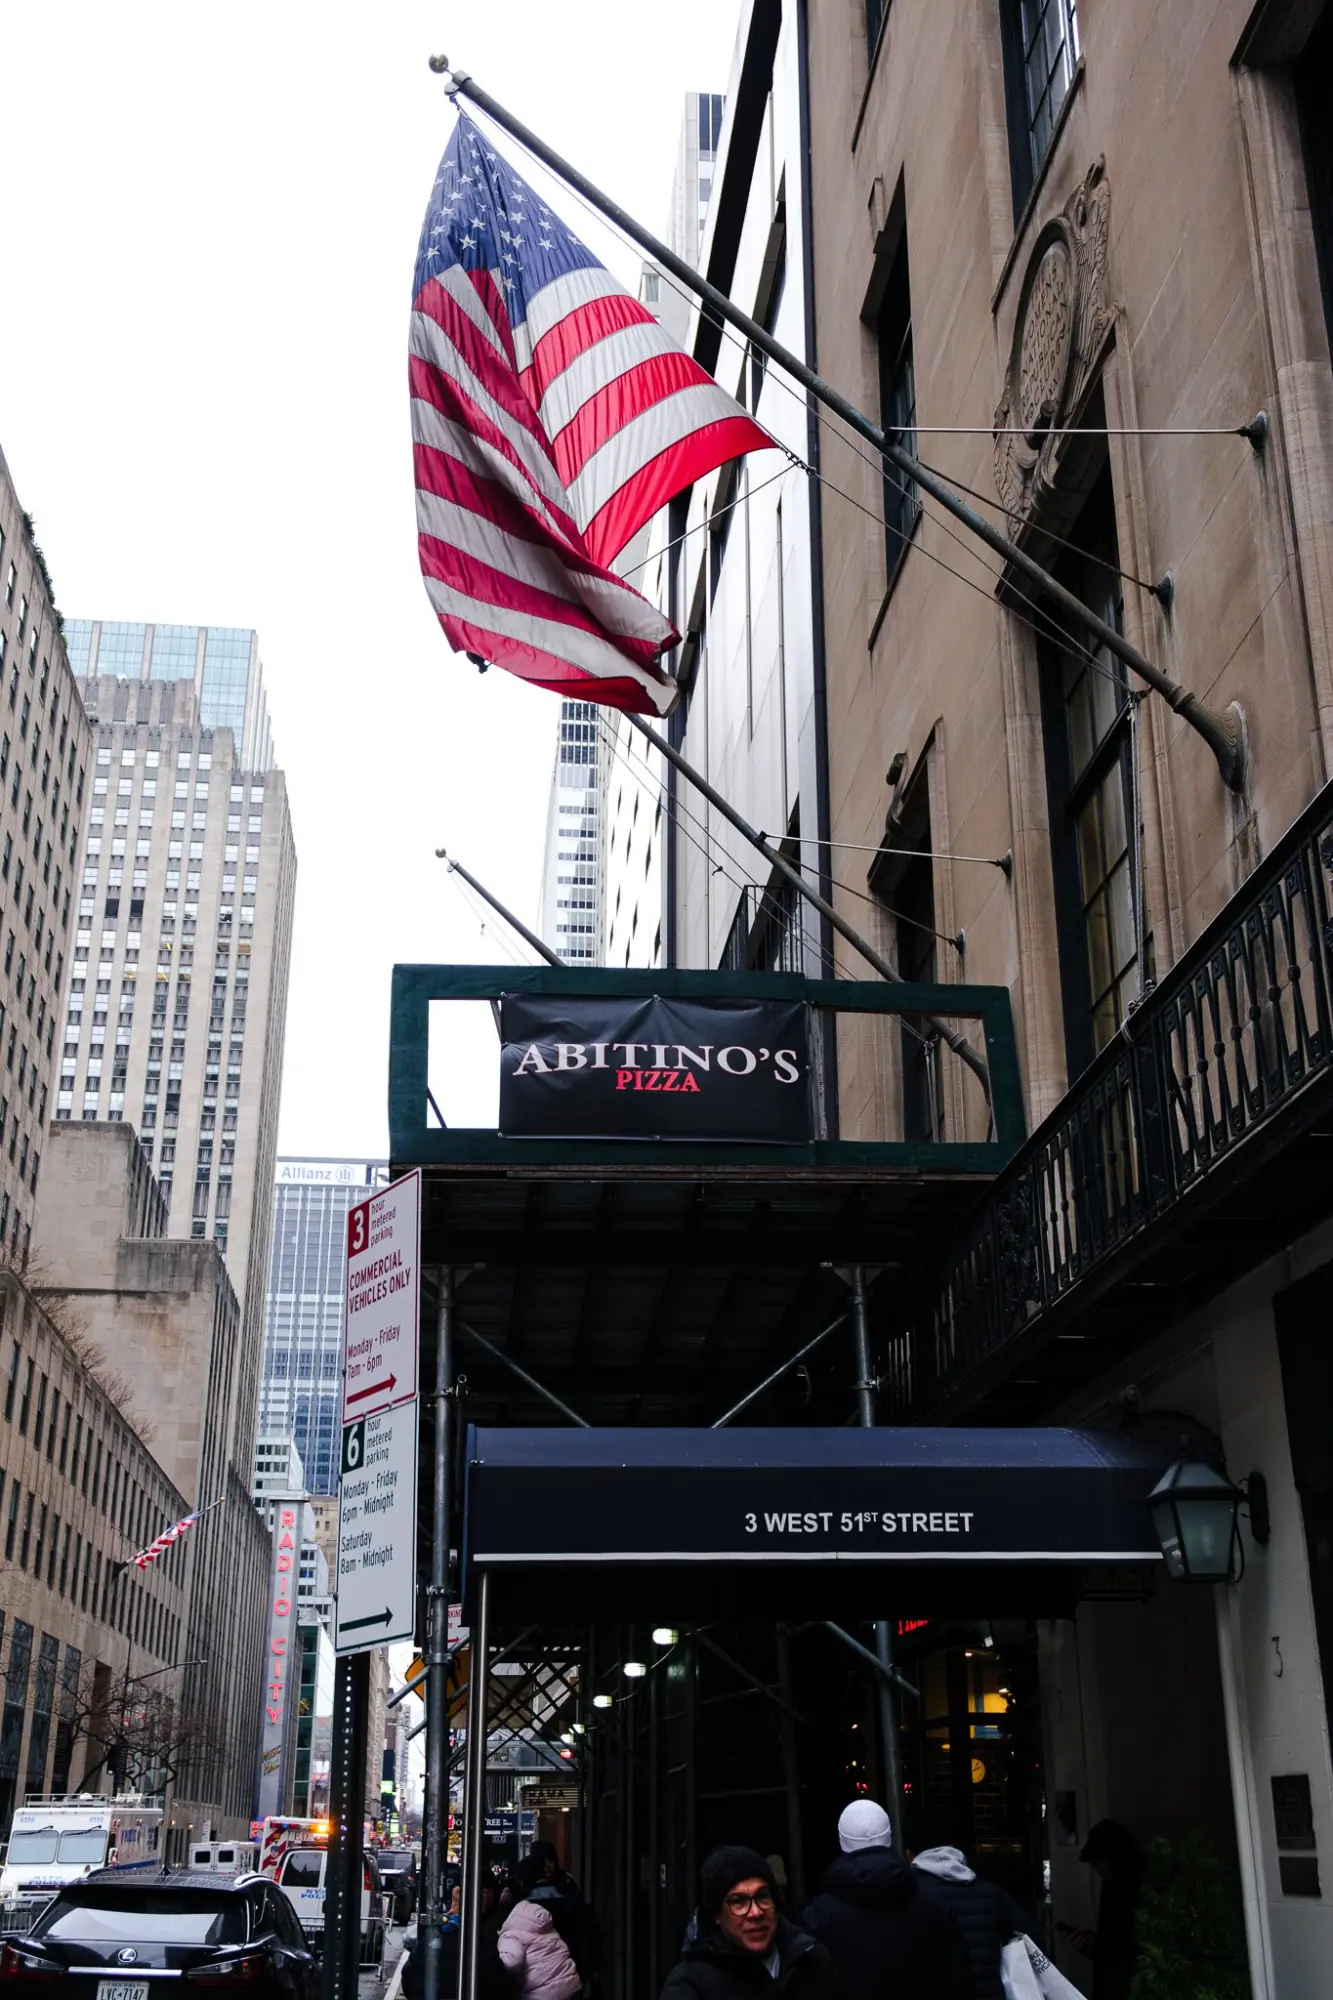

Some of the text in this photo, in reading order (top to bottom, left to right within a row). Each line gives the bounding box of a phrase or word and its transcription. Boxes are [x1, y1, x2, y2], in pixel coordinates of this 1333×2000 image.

[1022, 281, 1064, 382] NATIONAL
[1022, 293, 1067, 407] REPUBLICAN
[512, 1042, 800, 1084] ABITINO'S
[615, 1069, 701, 1092] PIZZA
[281, 1166, 332, 1180] Allianz
[371, 1199, 386, 1215] hour
[371, 1205, 397, 1228] metered
[353, 1209, 364, 1250] 3
[370, 1225, 393, 1248] parking
[350, 1249, 403, 1291] COMMERCIAL
[349, 1267, 411, 1314] VEHICLES ONLY
[347, 1336, 373, 1360] Monday
[379, 1323, 401, 1347] Friday
[367, 1352, 382, 1373] 6pm
[367, 1416, 382, 1433] hour
[367, 1429, 393, 1449] metered
[347, 1424, 359, 1467] 6
[366, 1447, 389, 1468] parking
[343, 1475, 370, 1501] Monday
[376, 1468, 398, 1490] Friday
[342, 1504, 358, 1525] 6pm
[364, 1493, 394, 1514] Midnight
[744, 1512, 758, 1533] 3
[764, 1512, 833, 1533] WEST
[882, 1512, 974, 1533] STREET
[341, 1529, 373, 1553] Saturday
[273, 1510, 295, 1617] RADIO
[340, 1556, 357, 1575] 8am
[362, 1546, 393, 1568] Midnight
[266, 1637, 288, 1725] CITY
